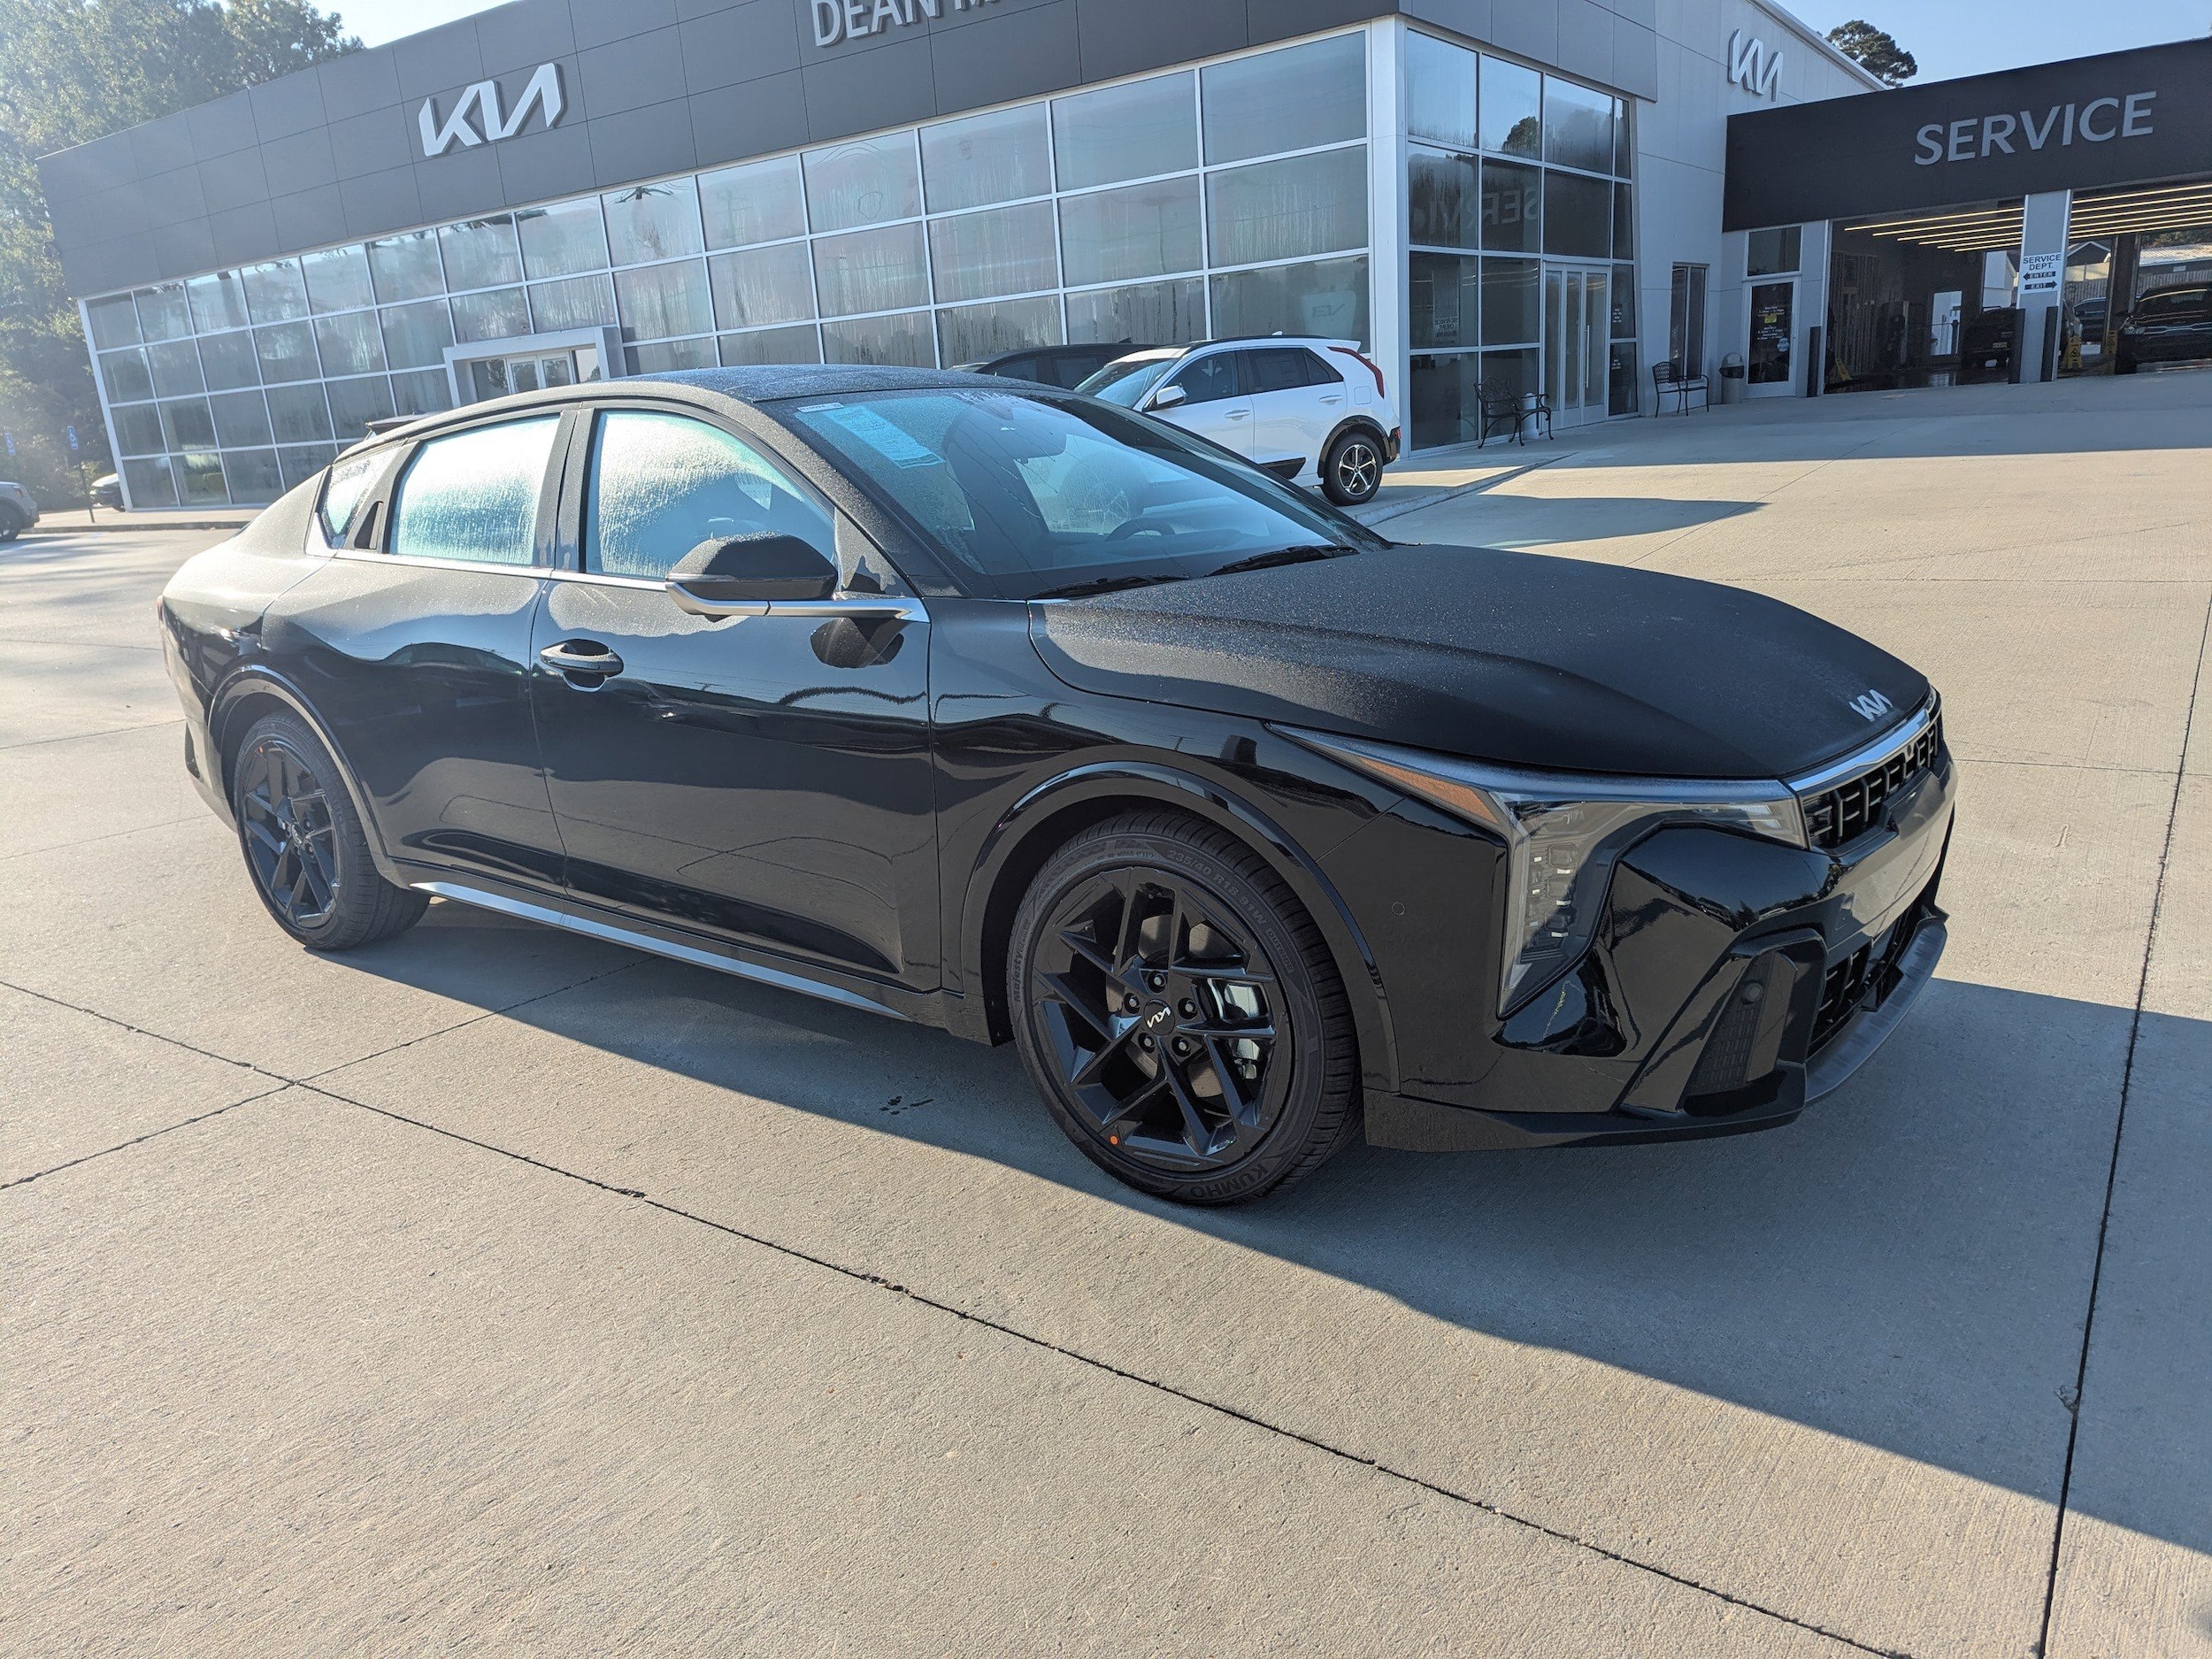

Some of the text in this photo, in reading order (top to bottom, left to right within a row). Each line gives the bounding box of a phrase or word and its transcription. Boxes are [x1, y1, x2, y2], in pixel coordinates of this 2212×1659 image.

[1728, 28, 1784, 102] KIA
[419, 63, 564, 157] KIA
[1915, 91, 2157, 165] SERVICE
[2023, 253, 2062, 265] SERVICE
[2029, 262, 2054, 271] DEPT.
[1849, 689, 1893, 722] KIA
[1168, 850, 1269, 926] 235/40 R18 91W
[1268, 930, 1294, 972] OUTSIDE
[1147, 1006, 1171, 1028] KIA
[1190, 1163, 1269, 1198] KUMHO
